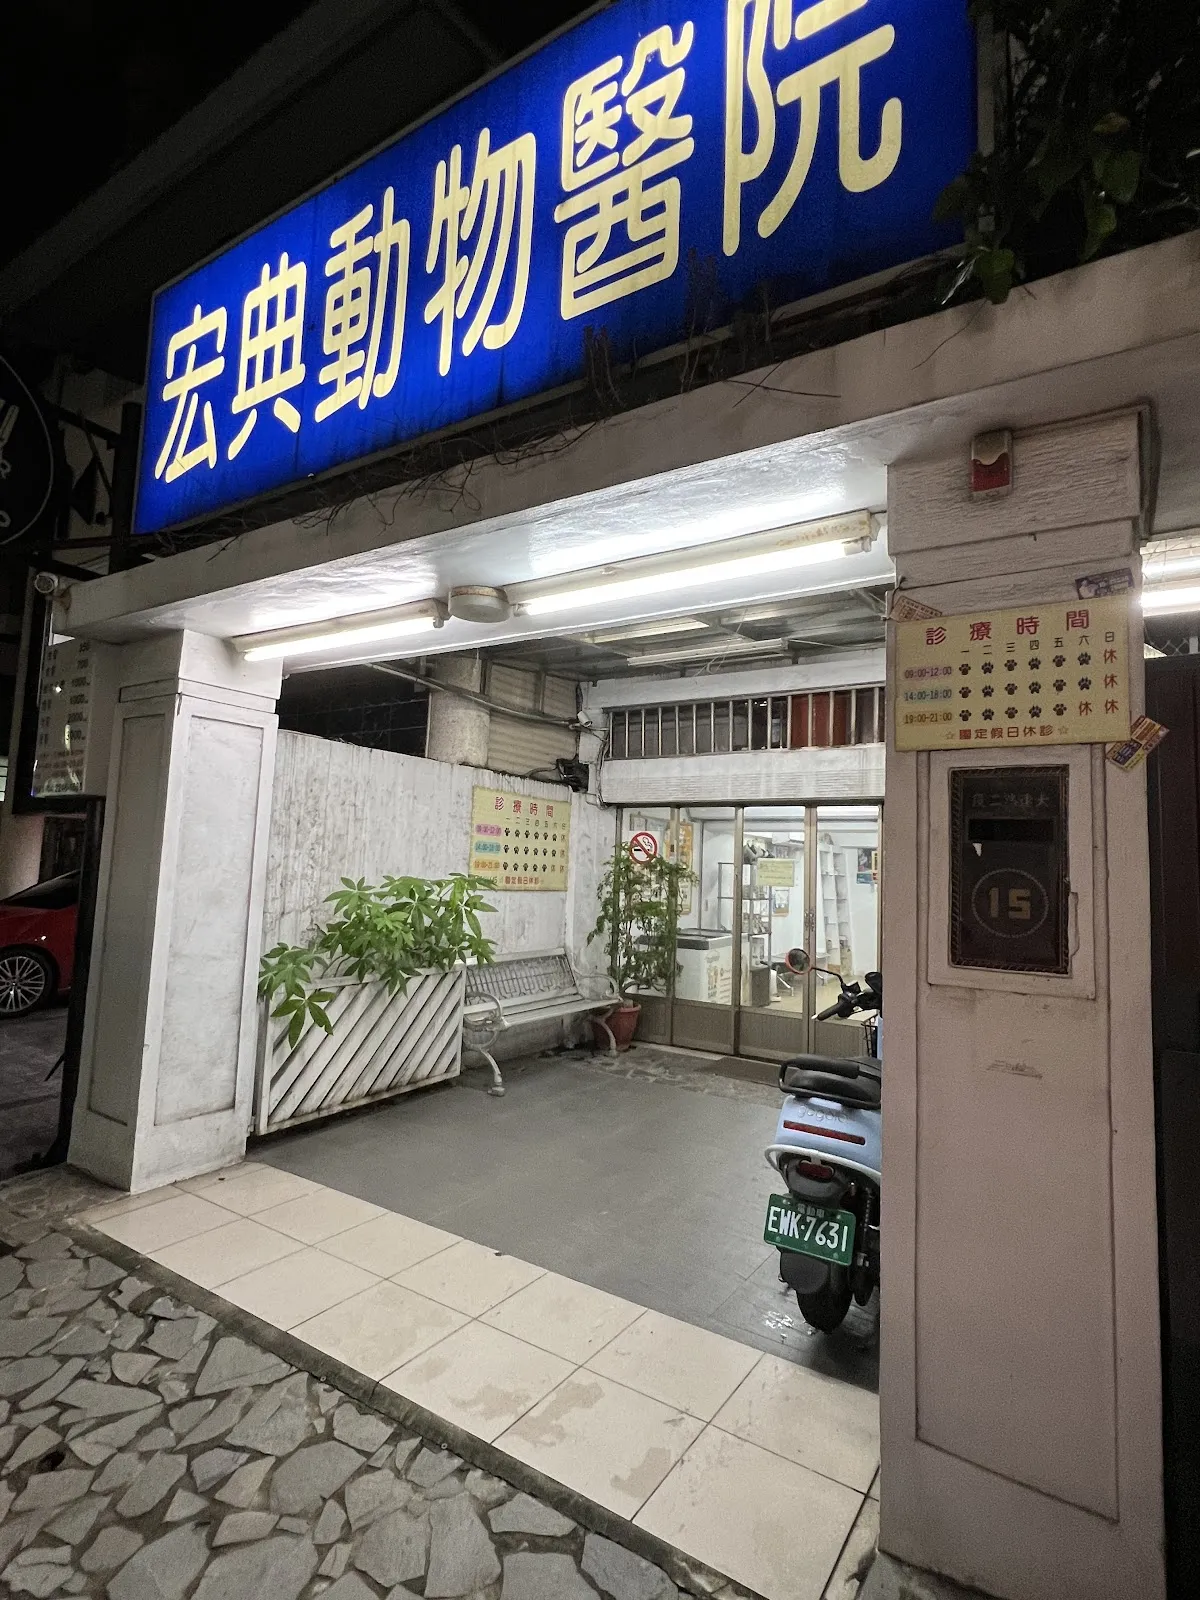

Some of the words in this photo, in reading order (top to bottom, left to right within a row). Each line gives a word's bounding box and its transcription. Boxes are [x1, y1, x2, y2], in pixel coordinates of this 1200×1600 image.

[155, 0, 902, 482] 宏典動物醫院
[926, 609, 1089, 646] 診療時間
[1103, 649, 1117, 664] 休
[905, 666, 952, 679] 09:00-12:00
[1103, 673, 1118, 688] 休
[905, 712, 952, 724] 19:00-21:00
[989, 887, 1031, 920] 15
